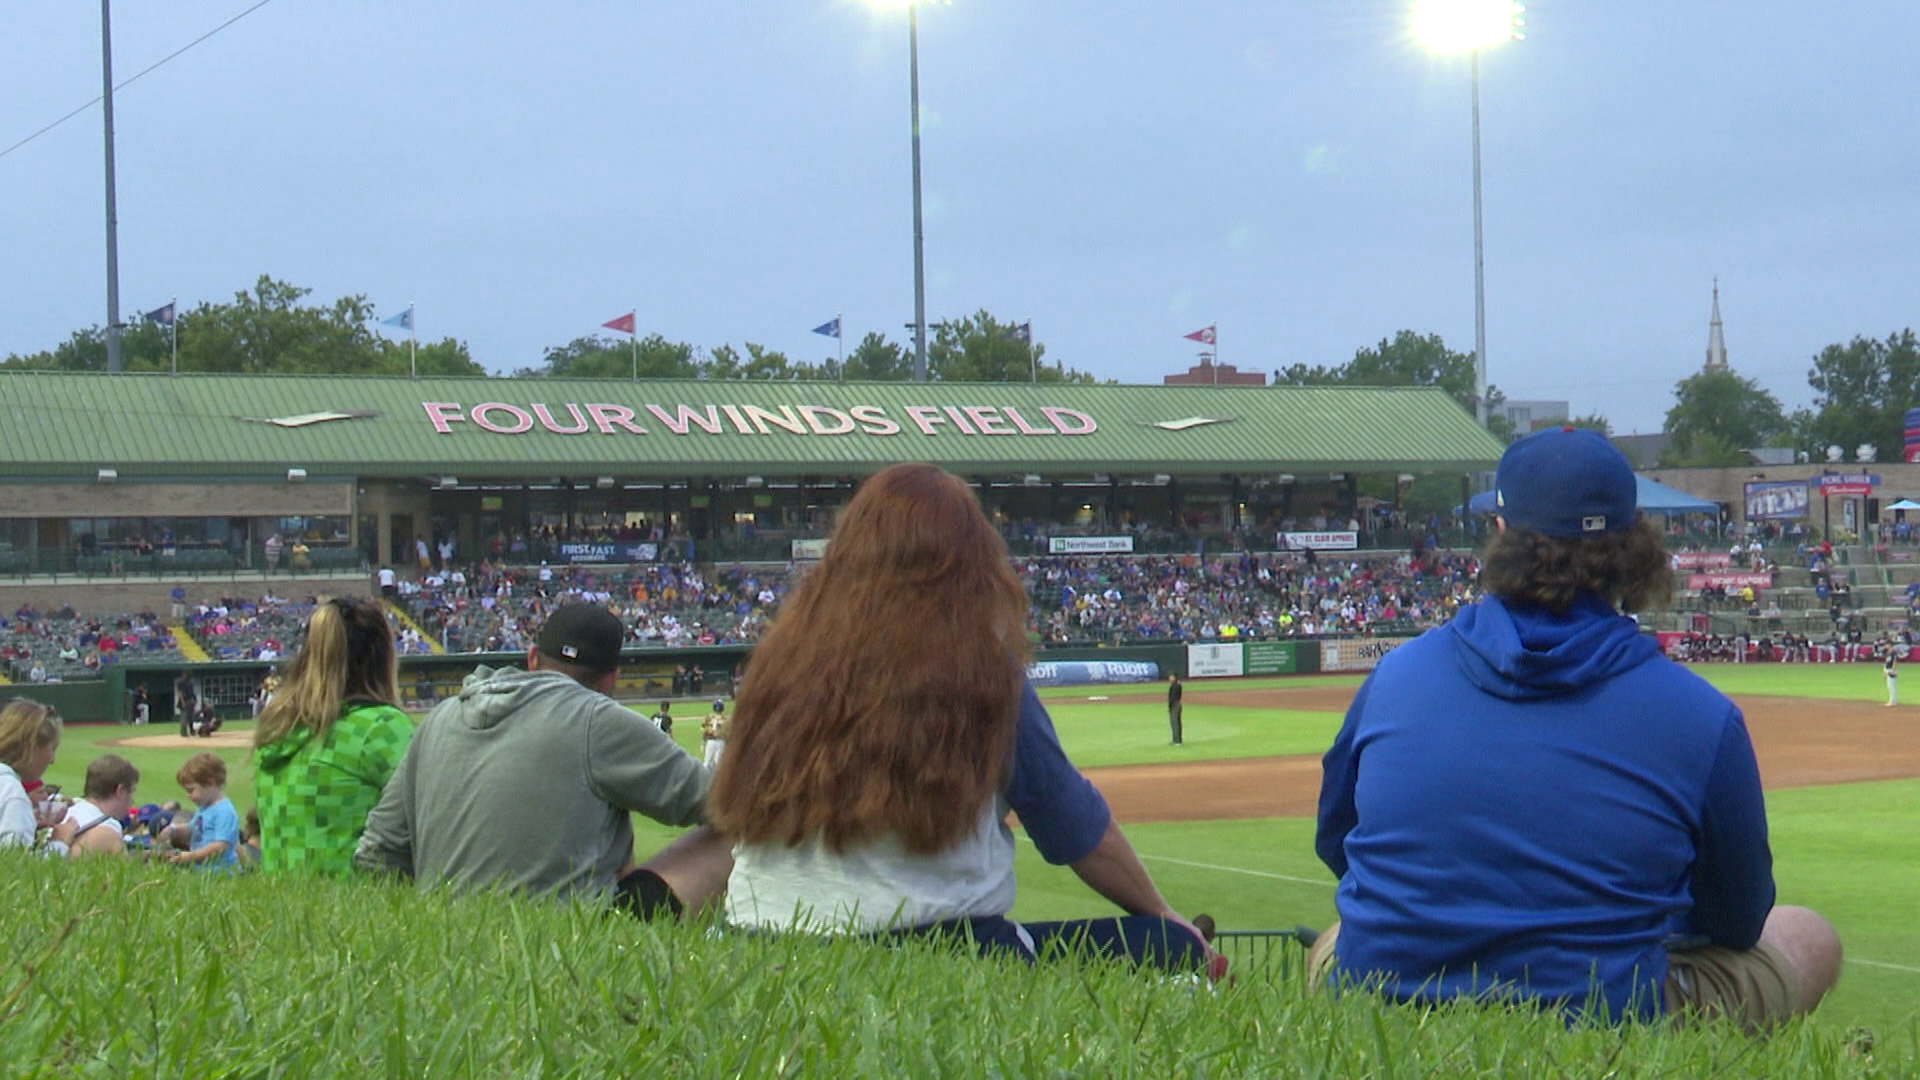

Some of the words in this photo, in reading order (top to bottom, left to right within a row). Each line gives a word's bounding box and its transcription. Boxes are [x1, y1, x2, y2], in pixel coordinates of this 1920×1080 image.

[422, 402, 649, 435] FOUR
[645, 403, 901, 435] WINDS
[904, 405, 1098, 435] FIELD
[1067, 540, 1107, 549] Northwest
[1108, 540, 1128, 549] Bank
[1711, 577, 1736, 585] PICNIC
[1737, 575, 1770, 584] GARDEN
[1107, 662, 1149, 675] Ruoff
